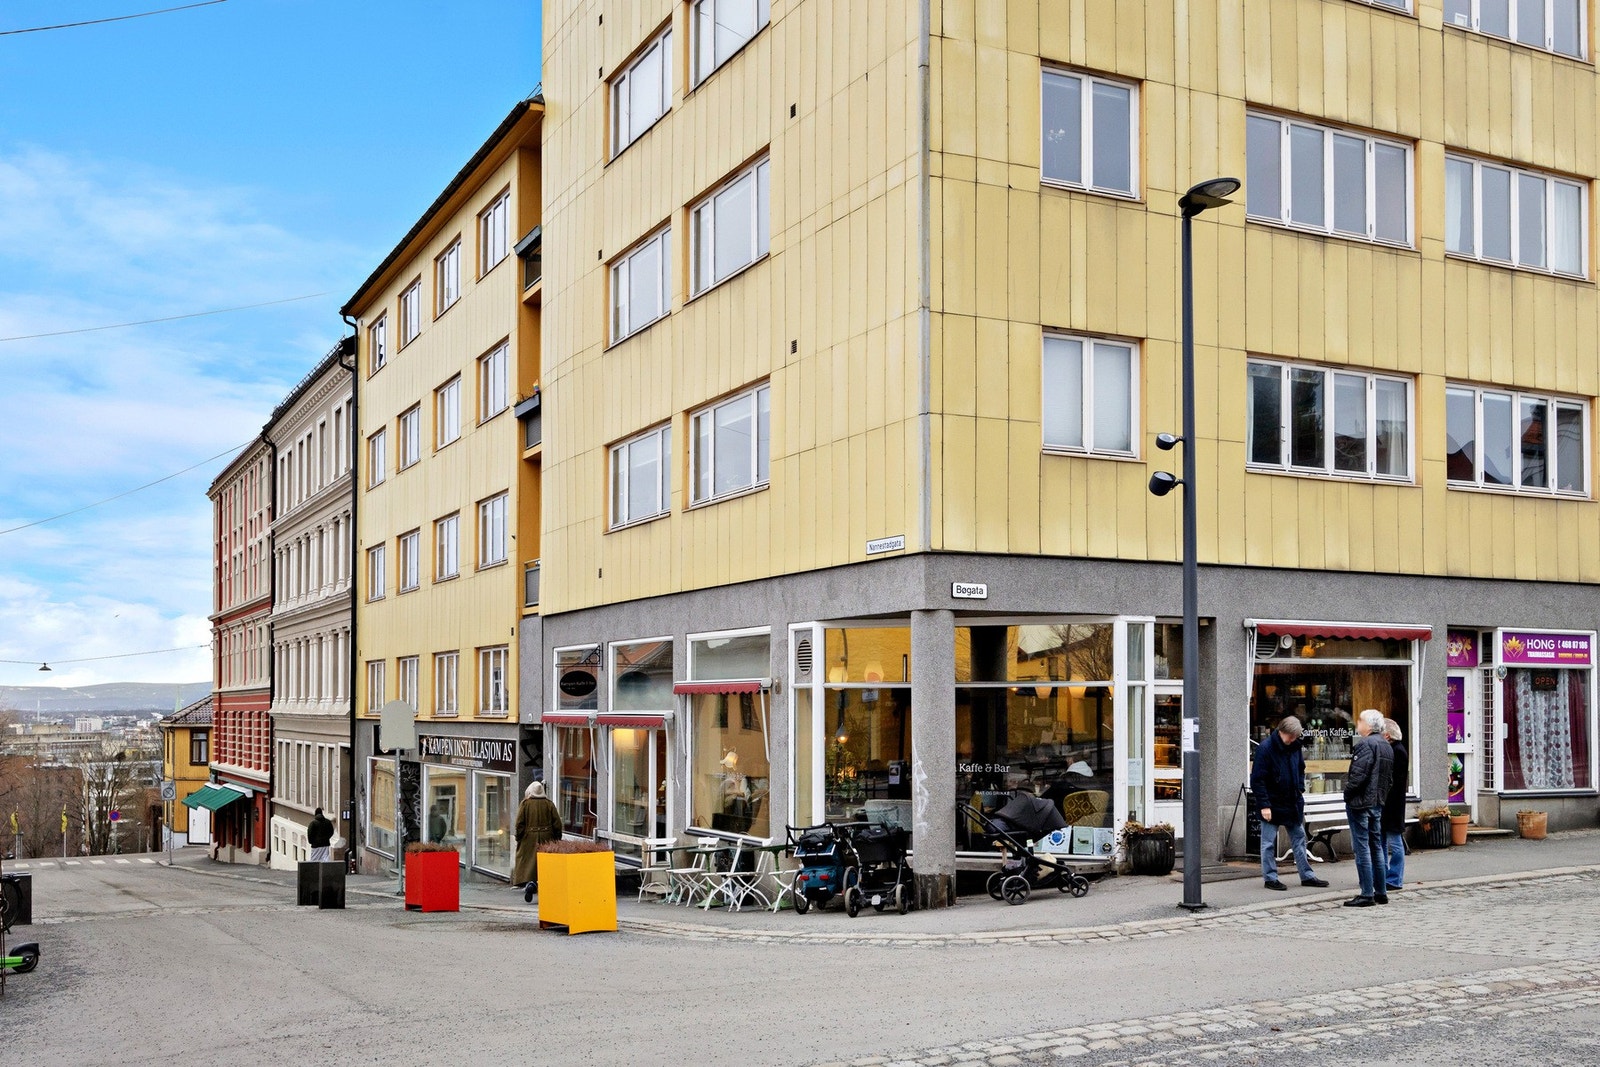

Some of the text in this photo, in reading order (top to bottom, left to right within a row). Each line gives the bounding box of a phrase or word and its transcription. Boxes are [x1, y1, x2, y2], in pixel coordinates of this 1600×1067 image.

[869, 540, 902, 552] Nannestadgata
[956, 585, 984, 596] Bøgata
[1526, 639, 1555, 650] HONG
[1535, 676, 1556, 685] OPEN
[1329, 727, 1347, 737] Kaffe
[428, 738, 453, 756] KAMPEN
[453, 740, 501, 764] INSTALLASJON
[502, 743, 513, 762] AS
[959, 763, 1011, 773] Kaffe & Bar
